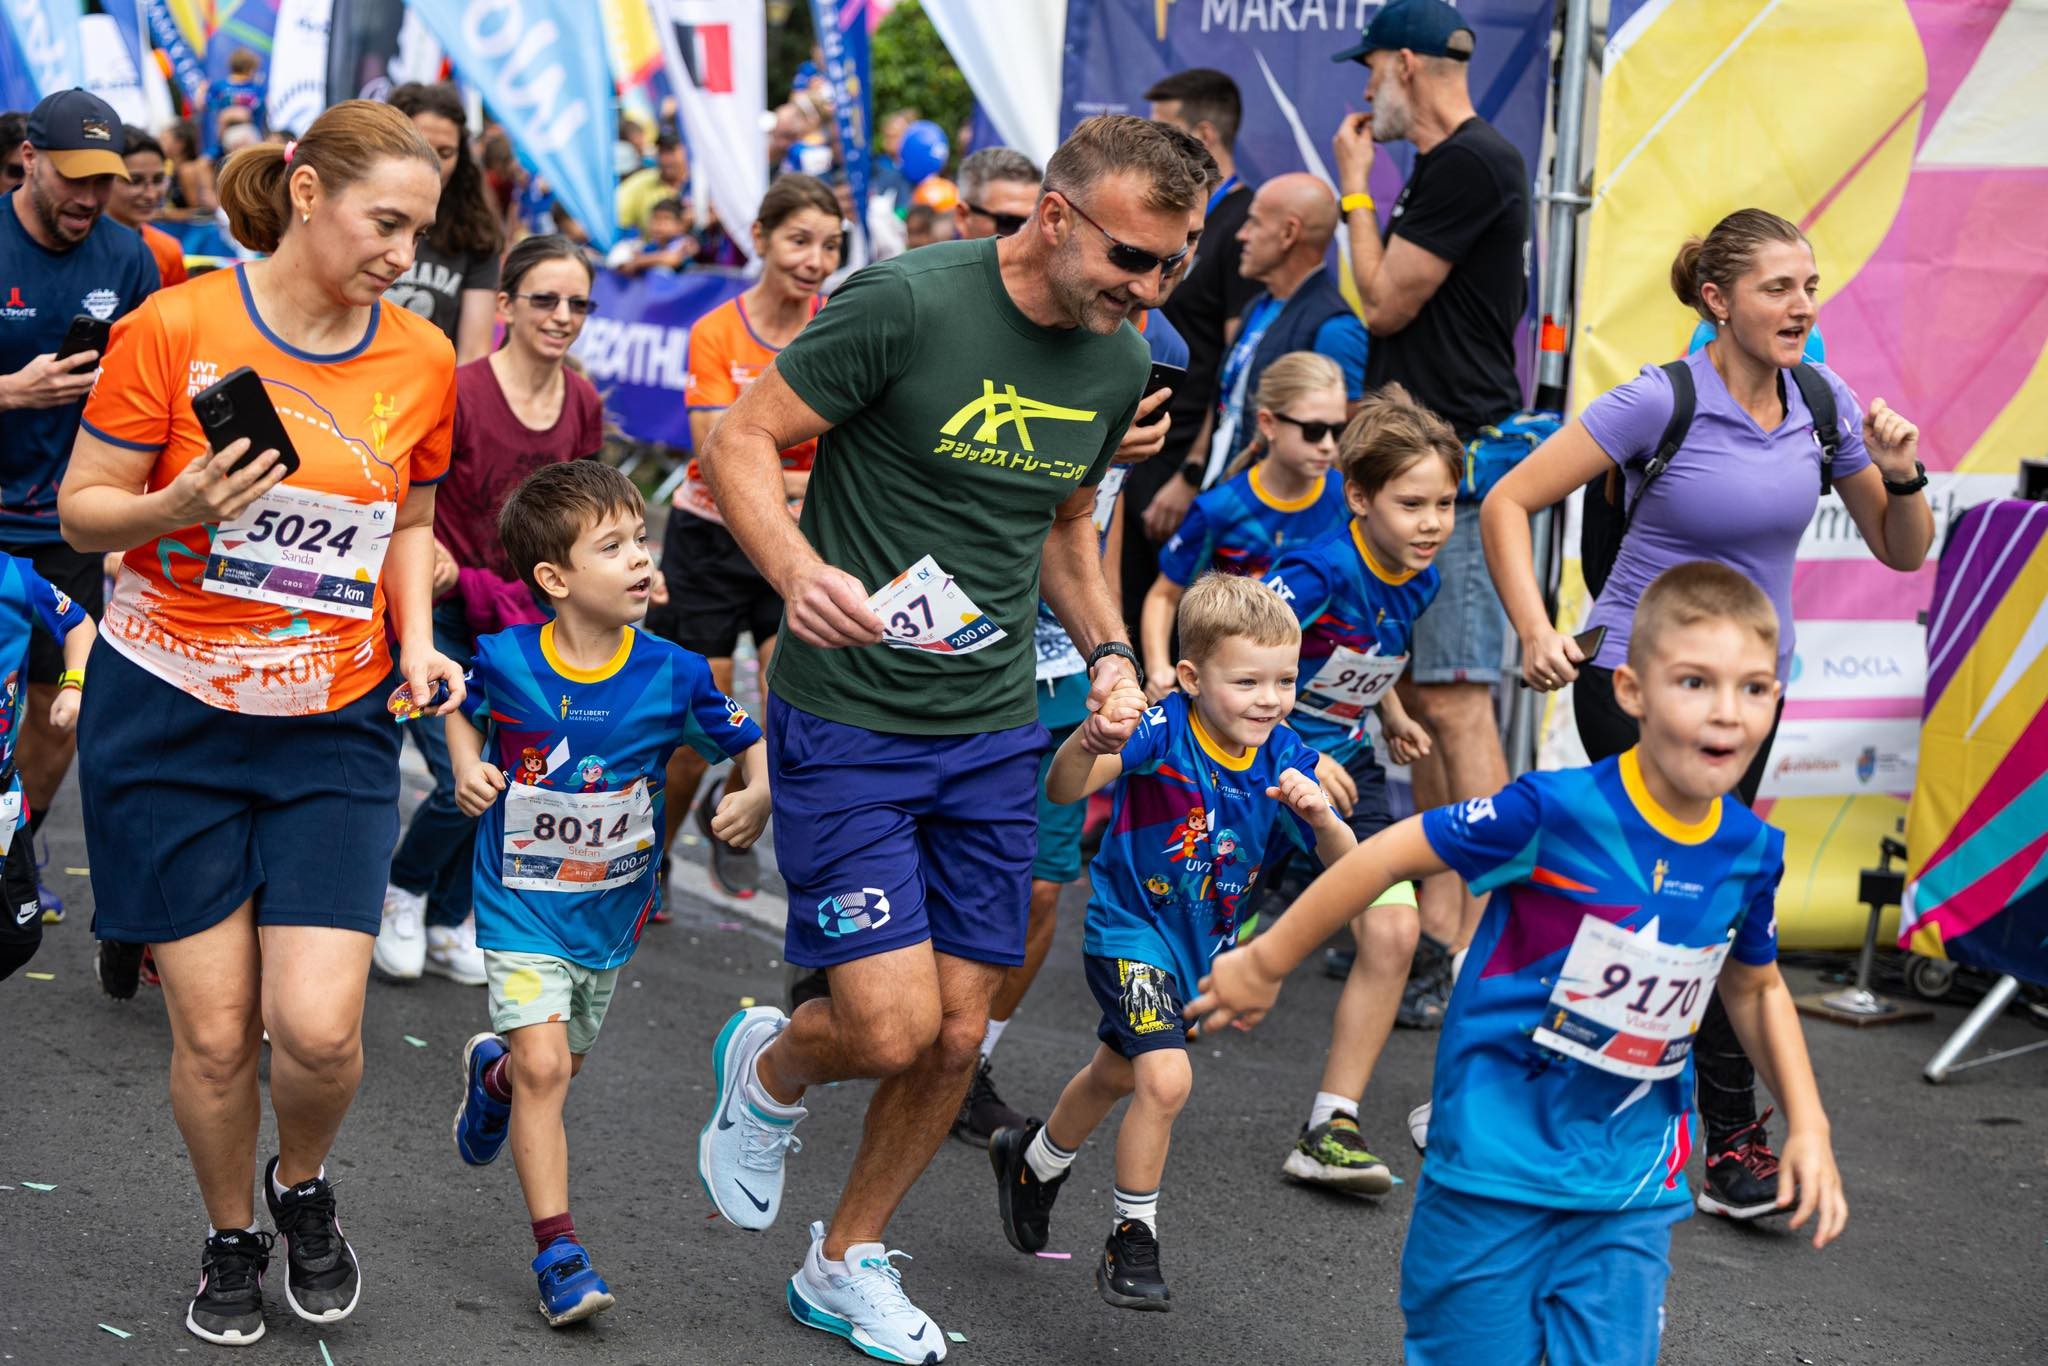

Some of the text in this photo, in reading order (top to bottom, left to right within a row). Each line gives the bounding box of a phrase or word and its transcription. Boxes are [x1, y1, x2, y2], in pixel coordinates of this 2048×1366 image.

[1200, 0, 1386, 33] MARATH
[0, 308, 36, 317] LTIMATE
[190, 361, 218, 375] UVT
[933, 438, 1009, 467] アシックス
[247, 510, 359, 557] 5024
[281, 549, 314, 567] Sanda
[282, 579, 303, 589] CROS
[333, 583, 365, 602] 2 km
[886, 594, 934, 638] 37
[951, 629, 978, 647] 200
[978, 623, 992, 636] m
[1332, 670, 1394, 694] 9167
[533, 813, 630, 848] 8014
[568, 845, 600, 858] Stefan
[611, 853, 650, 873] 400 m
[1215, 881, 1245, 895] erty
[19, 901, 38, 916] NIKE
[1594, 963, 1702, 1018] 9170
